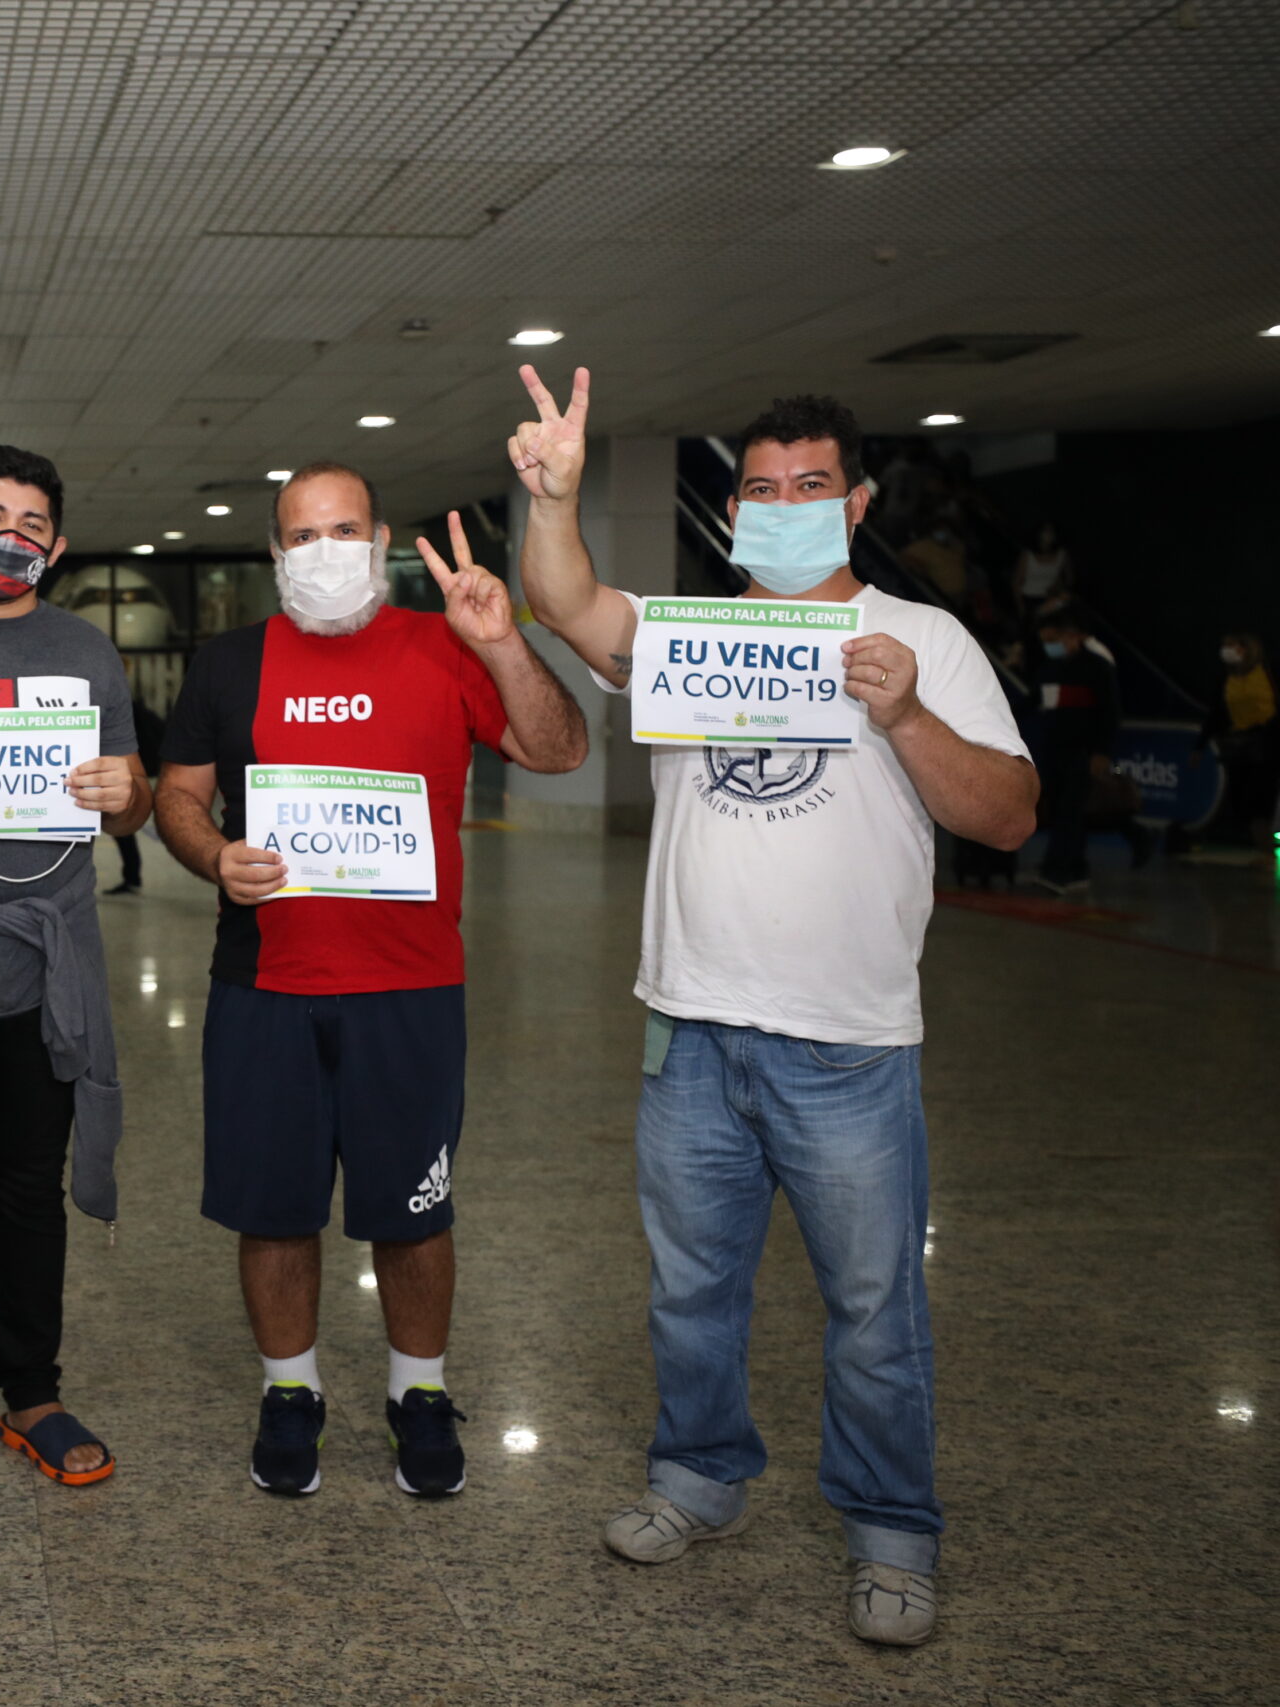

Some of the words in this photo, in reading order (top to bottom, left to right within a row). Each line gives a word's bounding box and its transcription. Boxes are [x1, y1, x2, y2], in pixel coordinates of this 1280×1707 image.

[650, 606, 661, 617] O
[663, 607, 732, 620] TRABALHO
[734, 609, 766, 621] FALA
[770, 610, 802, 623] PELA
[805, 612, 851, 626] GENTE
[669, 639, 708, 665] EU
[717, 641, 819, 671] VENCI
[651, 672, 672, 695] A
[683, 673, 837, 702] COVID-19
[284, 694, 373, 723] NEGO
[0, 717, 25, 727] FALA
[28, 716, 54, 726] PELA
[56, 715, 91, 726] GENTE
[750, 715, 789, 725] AMAZONAS
[256, 775, 265, 784] O
[267, 774, 328, 784] TRABALHO
[330, 776, 355, 785] FALA
[358, 777, 382, 787] PELA
[384, 779, 417, 791] GENTE
[16, 808, 48, 817] AMAZONAS
[277, 803, 311, 825] EU
[319, 803, 402, 826] VENCI
[766, 787, 836, 822] BRASIL
[264, 832, 282, 852] A
[290, 832, 417, 854] COVID-19
[348, 867, 380, 877] AMAZONAS
